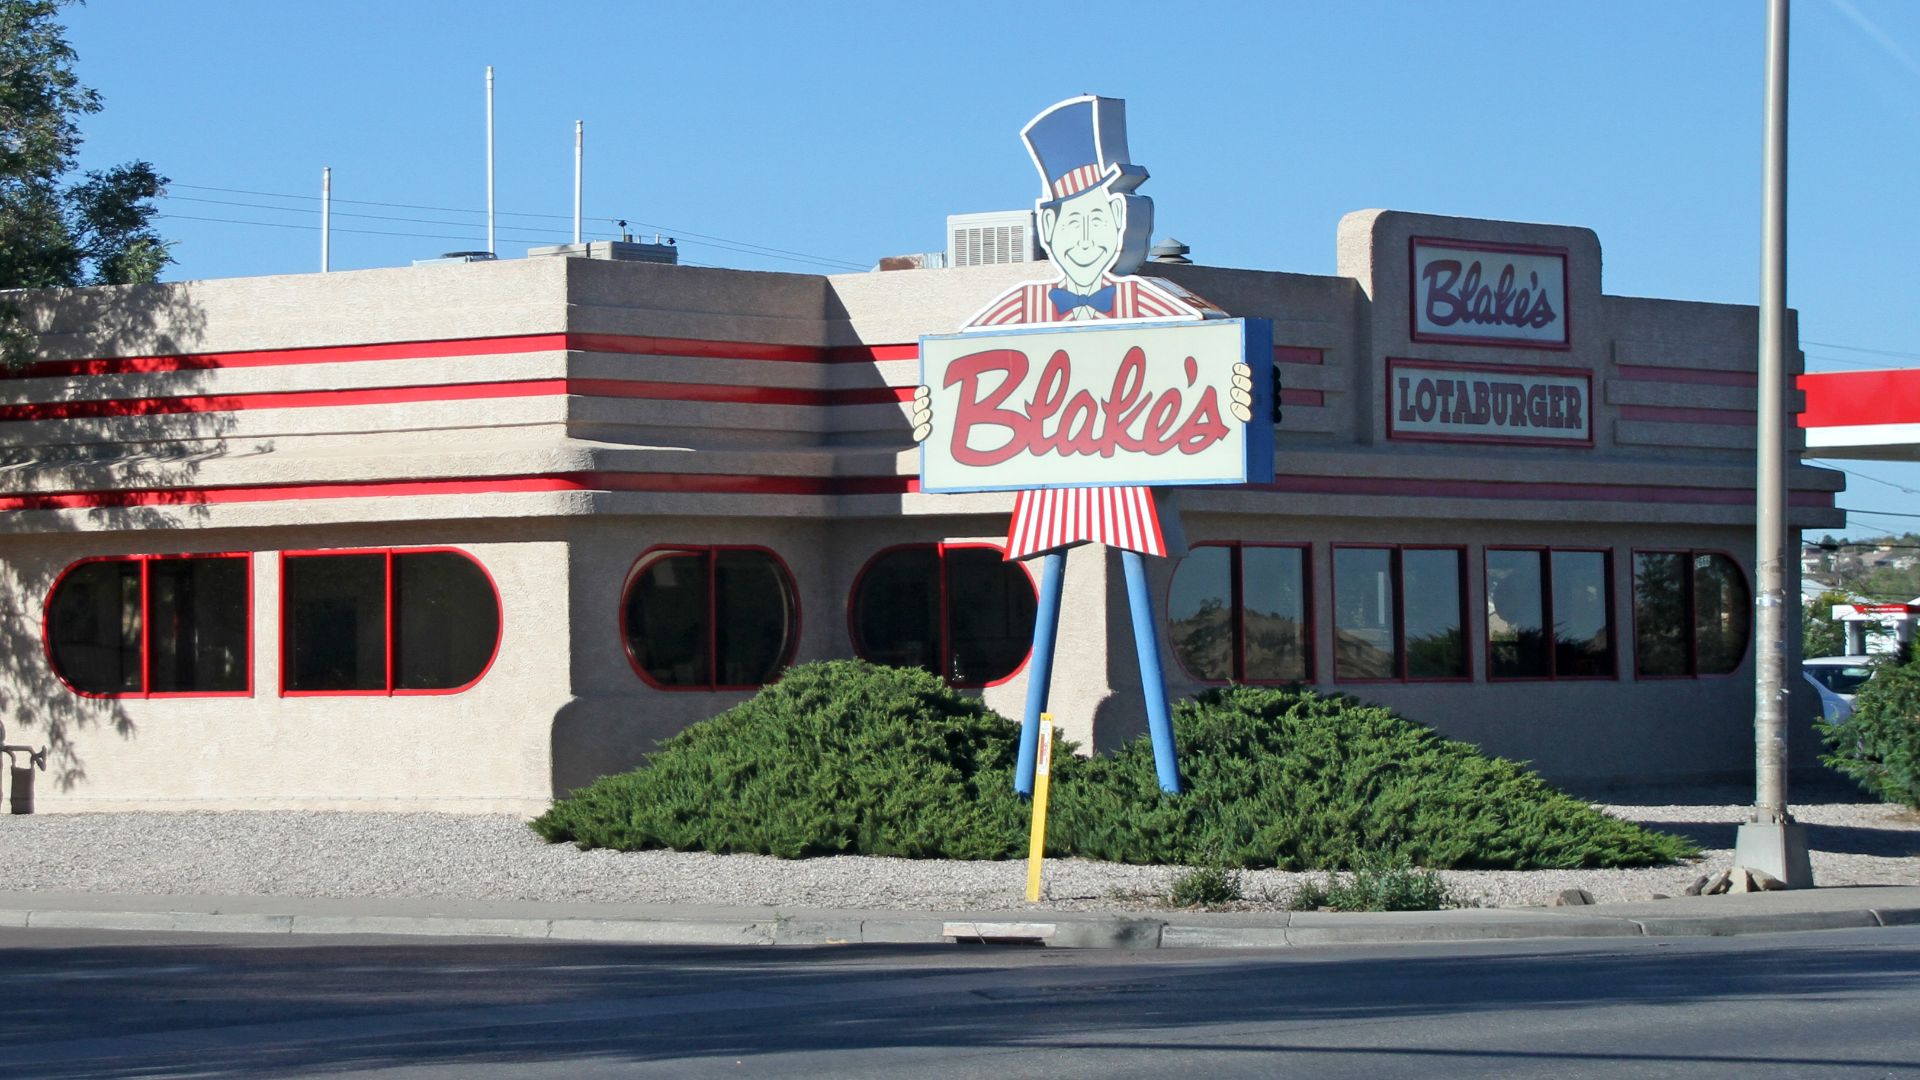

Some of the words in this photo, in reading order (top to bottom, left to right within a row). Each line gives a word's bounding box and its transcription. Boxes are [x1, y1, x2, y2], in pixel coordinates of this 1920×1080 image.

[1423, 259, 1556, 329] Blake's
[943, 346, 1230, 467] Blake's
[1399, 377, 1582, 429] LOTABURGER
